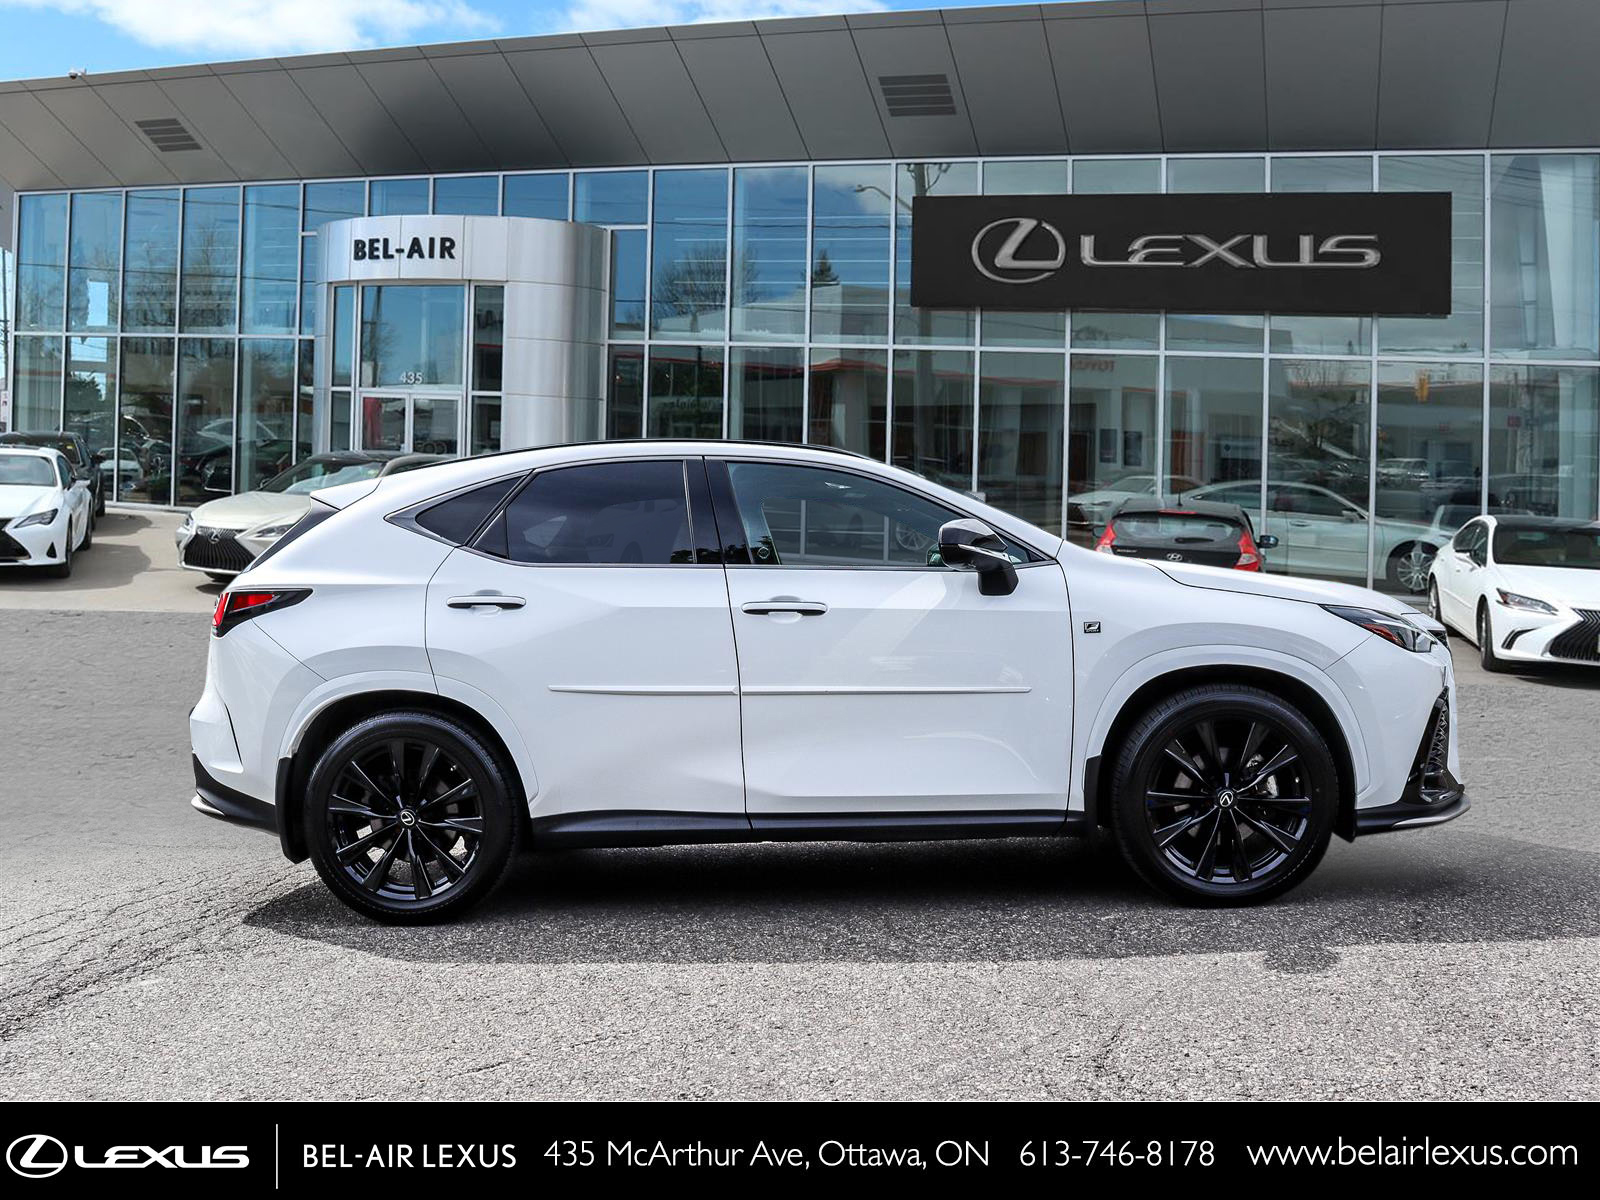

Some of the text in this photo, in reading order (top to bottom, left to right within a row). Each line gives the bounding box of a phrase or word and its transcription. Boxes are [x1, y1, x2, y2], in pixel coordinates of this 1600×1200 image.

[353, 236, 456, 261] BEL-AIR
[1080, 234, 1381, 269] LEXUS
[400, 371, 423, 385] 435
